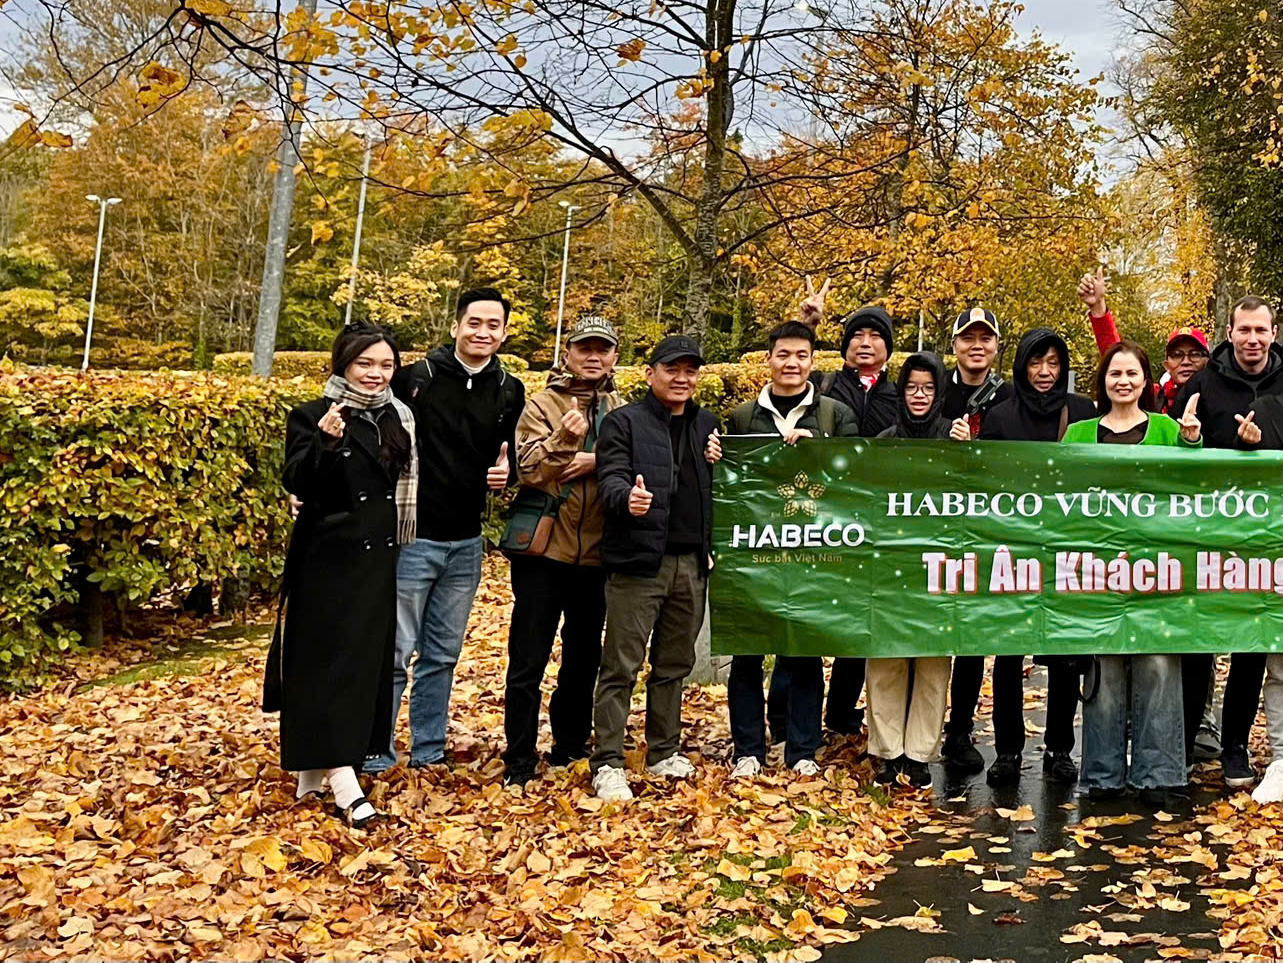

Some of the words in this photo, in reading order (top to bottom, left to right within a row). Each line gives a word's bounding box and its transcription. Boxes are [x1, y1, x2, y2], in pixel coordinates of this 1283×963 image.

[886, 492, 1043, 517] HABECO
[1054, 486, 1156, 517] VỮNG
[1168, 486, 1270, 518] BƯỚC
[732, 523, 865, 548] HABECO
[922, 551, 980, 594] Tri
[989, 544, 1043, 594] Ân
[1055, 551, 1184, 594] Khách
